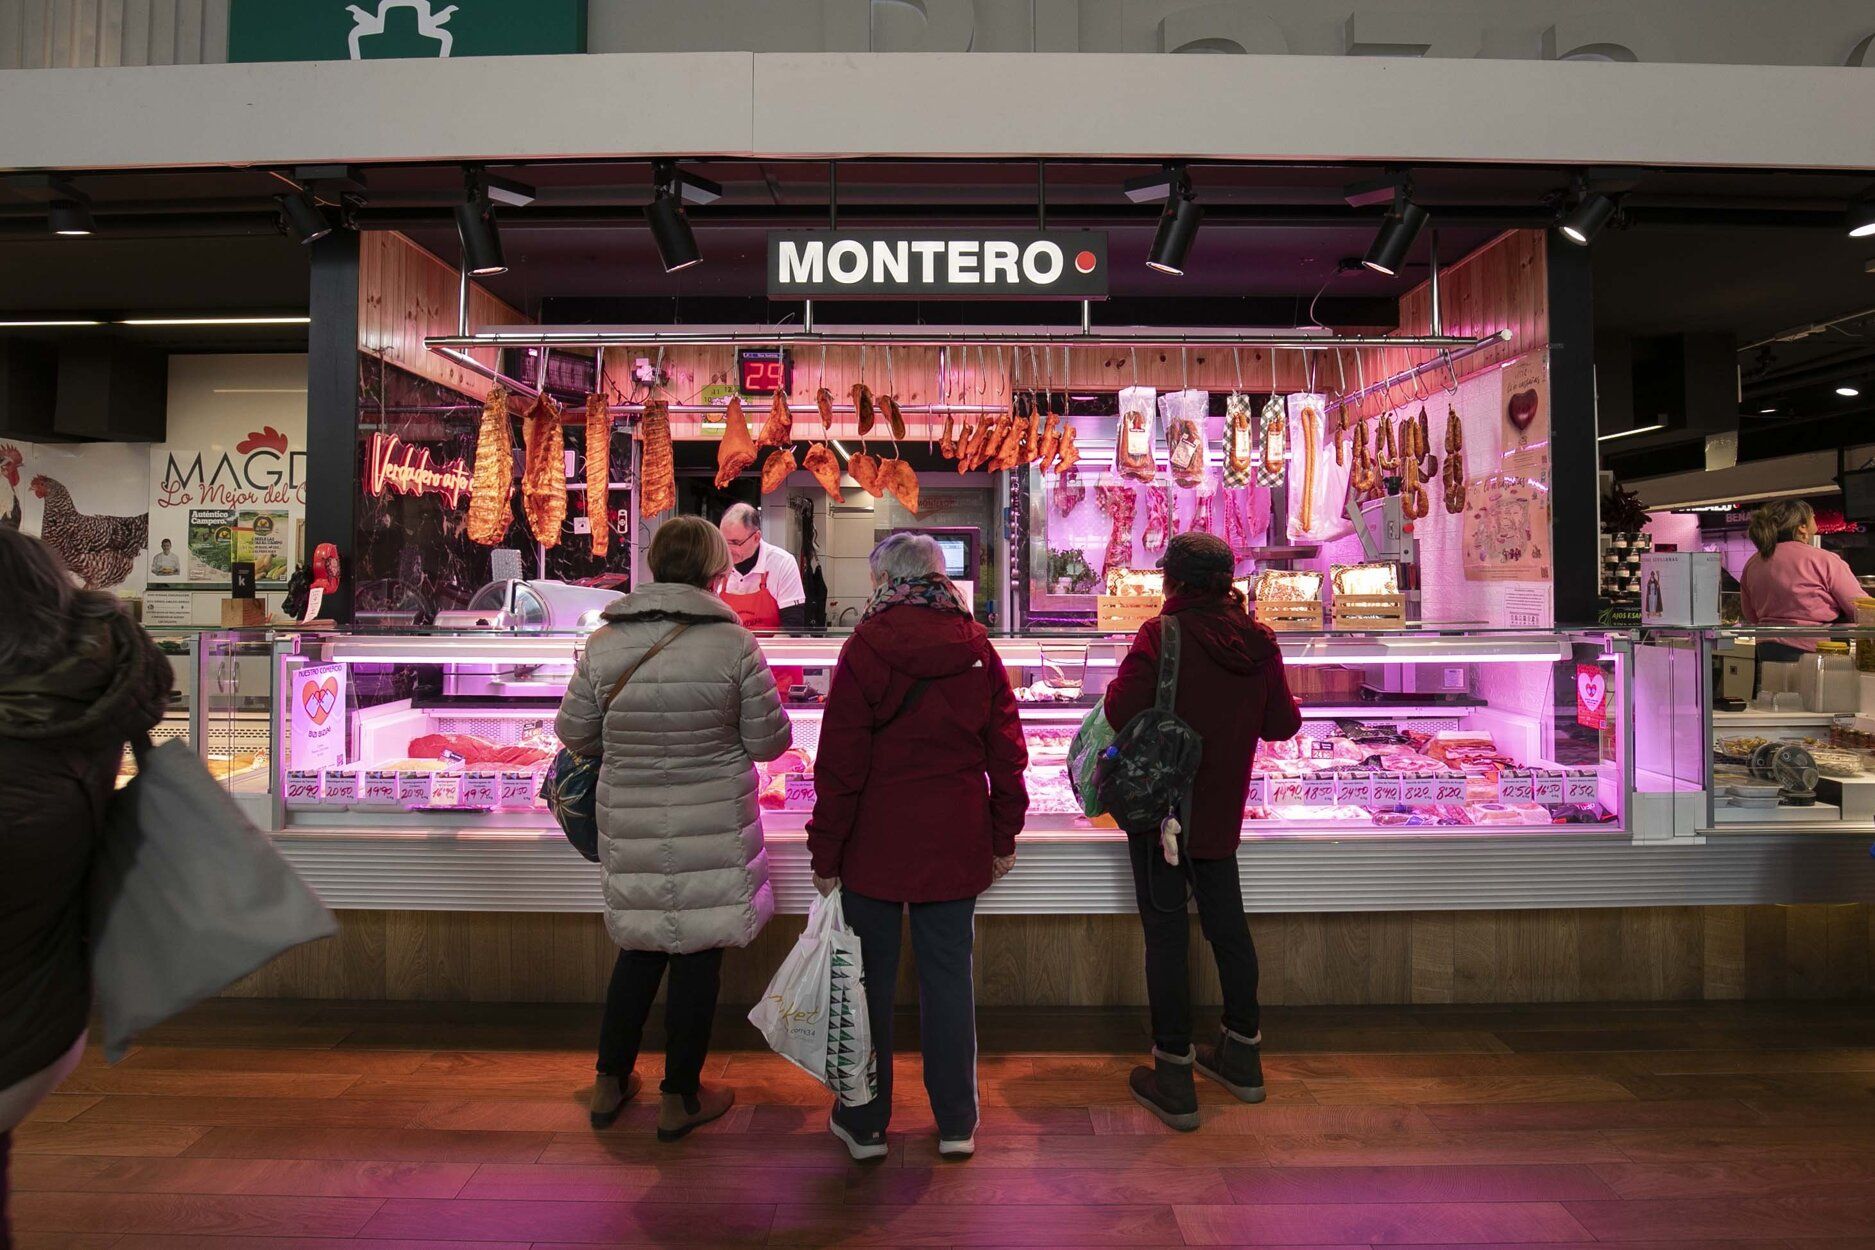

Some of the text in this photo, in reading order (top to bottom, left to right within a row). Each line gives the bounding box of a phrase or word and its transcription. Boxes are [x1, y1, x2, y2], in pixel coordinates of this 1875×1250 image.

[779, 239, 1064, 285] MONTERO
[745, 363, 784, 390] 29
[158, 480, 193, 508] Lo
[199, 483, 258, 511] Mejor
[264, 482, 290, 503] del
[191, 510, 229, 518] Auténtico
